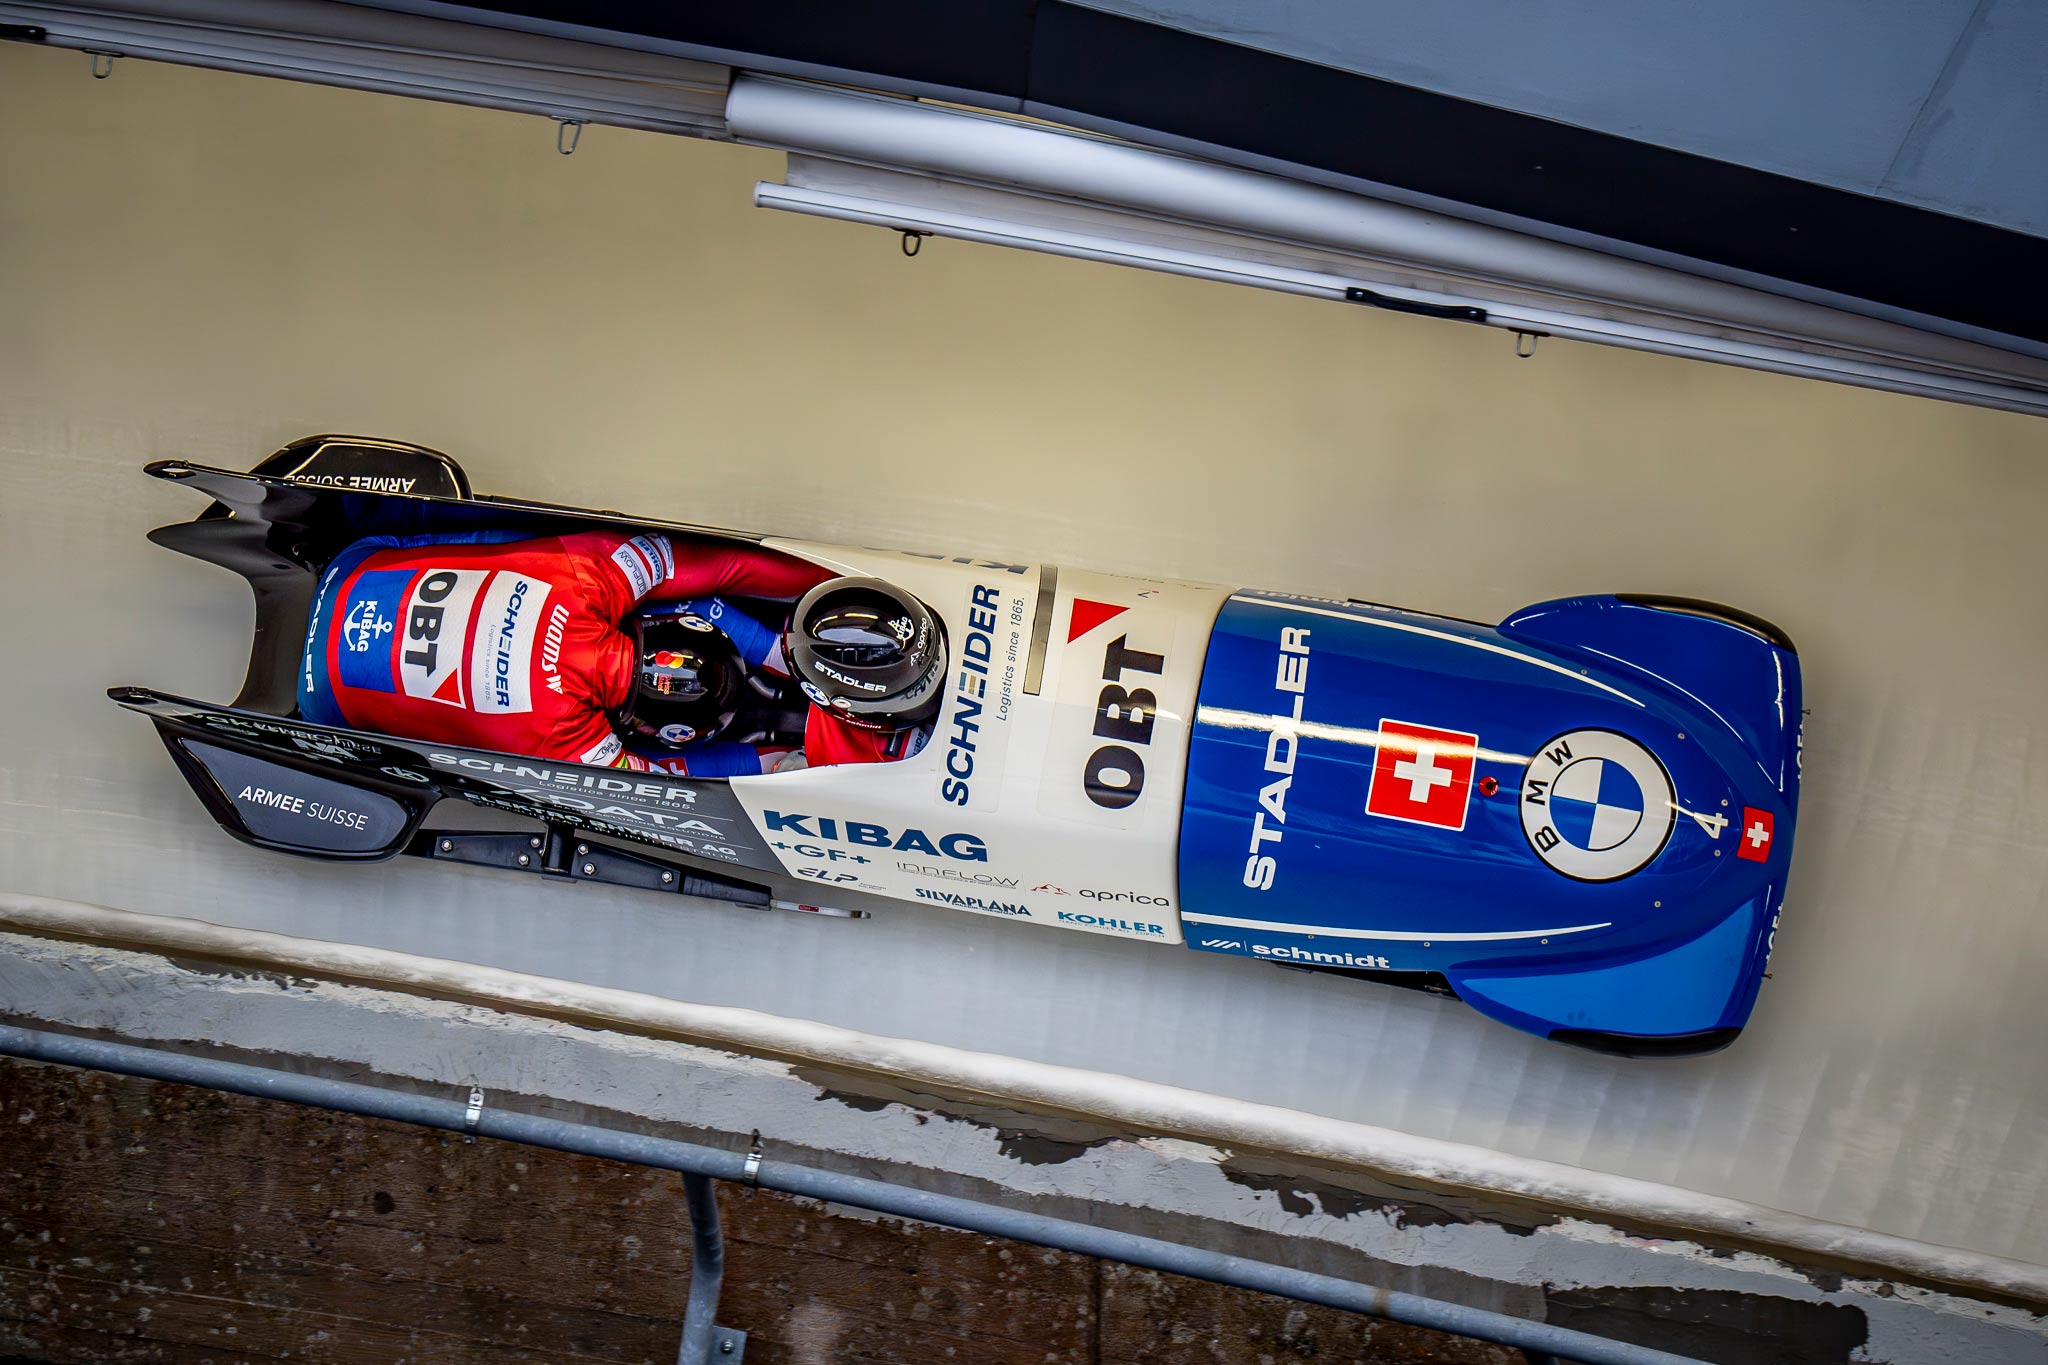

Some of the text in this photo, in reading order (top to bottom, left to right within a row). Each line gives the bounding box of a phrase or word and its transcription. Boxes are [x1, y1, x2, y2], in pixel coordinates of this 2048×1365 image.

[350, 475, 416, 494] ARMEE
[306, 566, 339, 693] STADLER
[357, 600, 378, 653] KIBAG
[404, 571, 459, 679] OBT
[495, 580, 528, 707] SCHNEIDER
[814, 661, 887, 692] STADLER
[996, 597, 1025, 721] Logistics since 1865.
[942, 584, 1000, 807] SCHNEIDER
[1084, 632, 1165, 810] OBT
[428, 753, 698, 804] SCHNEIDER
[1243, 626, 1311, 891] STADLER
[237, 785, 369, 831] ARMEE SUISSE
[539, 780, 602, 798] Logistics
[608, 792, 647, 803] since
[1525, 740, 1574, 853] BMW
[463, 791, 582, 823] ELEKTRO
[588, 818, 695, 848] RHYNER
[703, 844, 737, 857] AG
[763, 810, 989, 863] KIBAG
[1694, 811, 1729, 839] 4
[915, 887, 1033, 917] SILVAPLANA
[1058, 911, 1165, 935] KOHLER
[1079, 888, 1171, 907] aprica
[1251, 944, 1390, 969] schmidt
